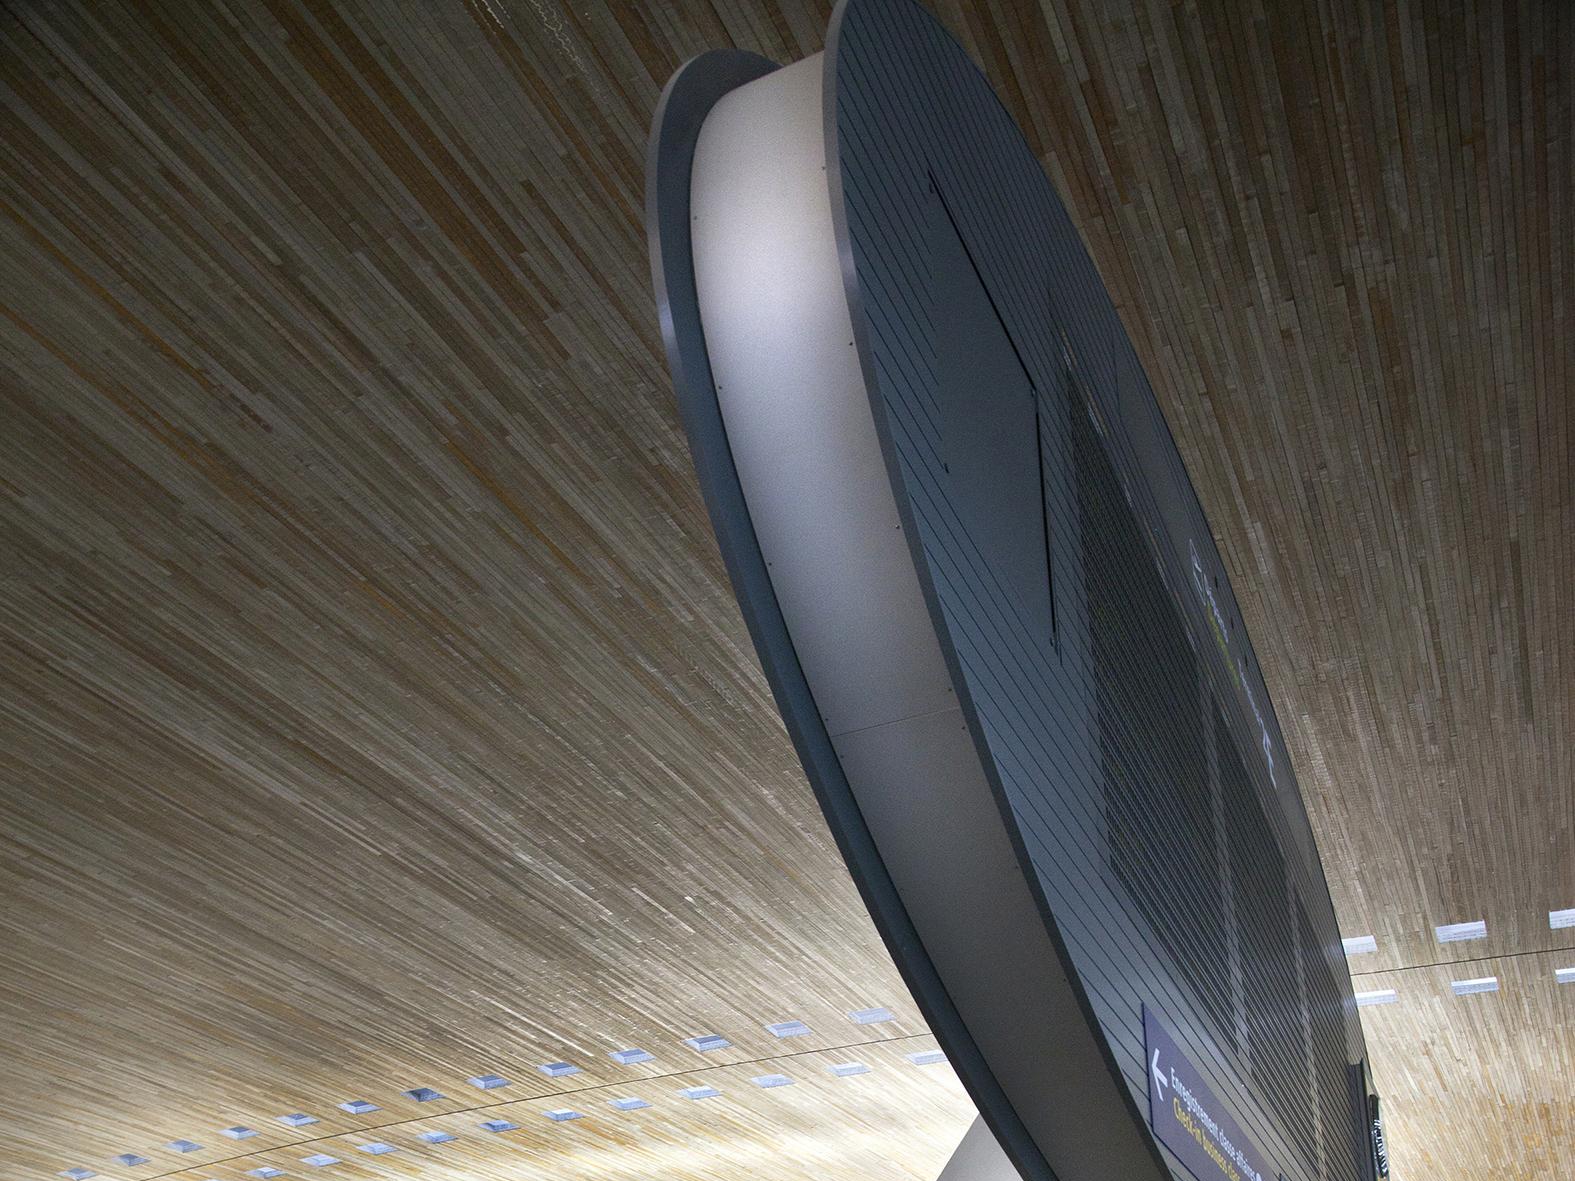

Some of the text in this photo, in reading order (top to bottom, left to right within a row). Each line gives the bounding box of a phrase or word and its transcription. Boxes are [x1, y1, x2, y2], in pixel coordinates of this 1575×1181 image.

[1170, 1066, 1219, 1141] Enregistrement
[1219, 1128, 1237, 1160] classe
[1173, 1097, 1202, 1145] Check-in
[1201, 1126, 1228, 1174] business
